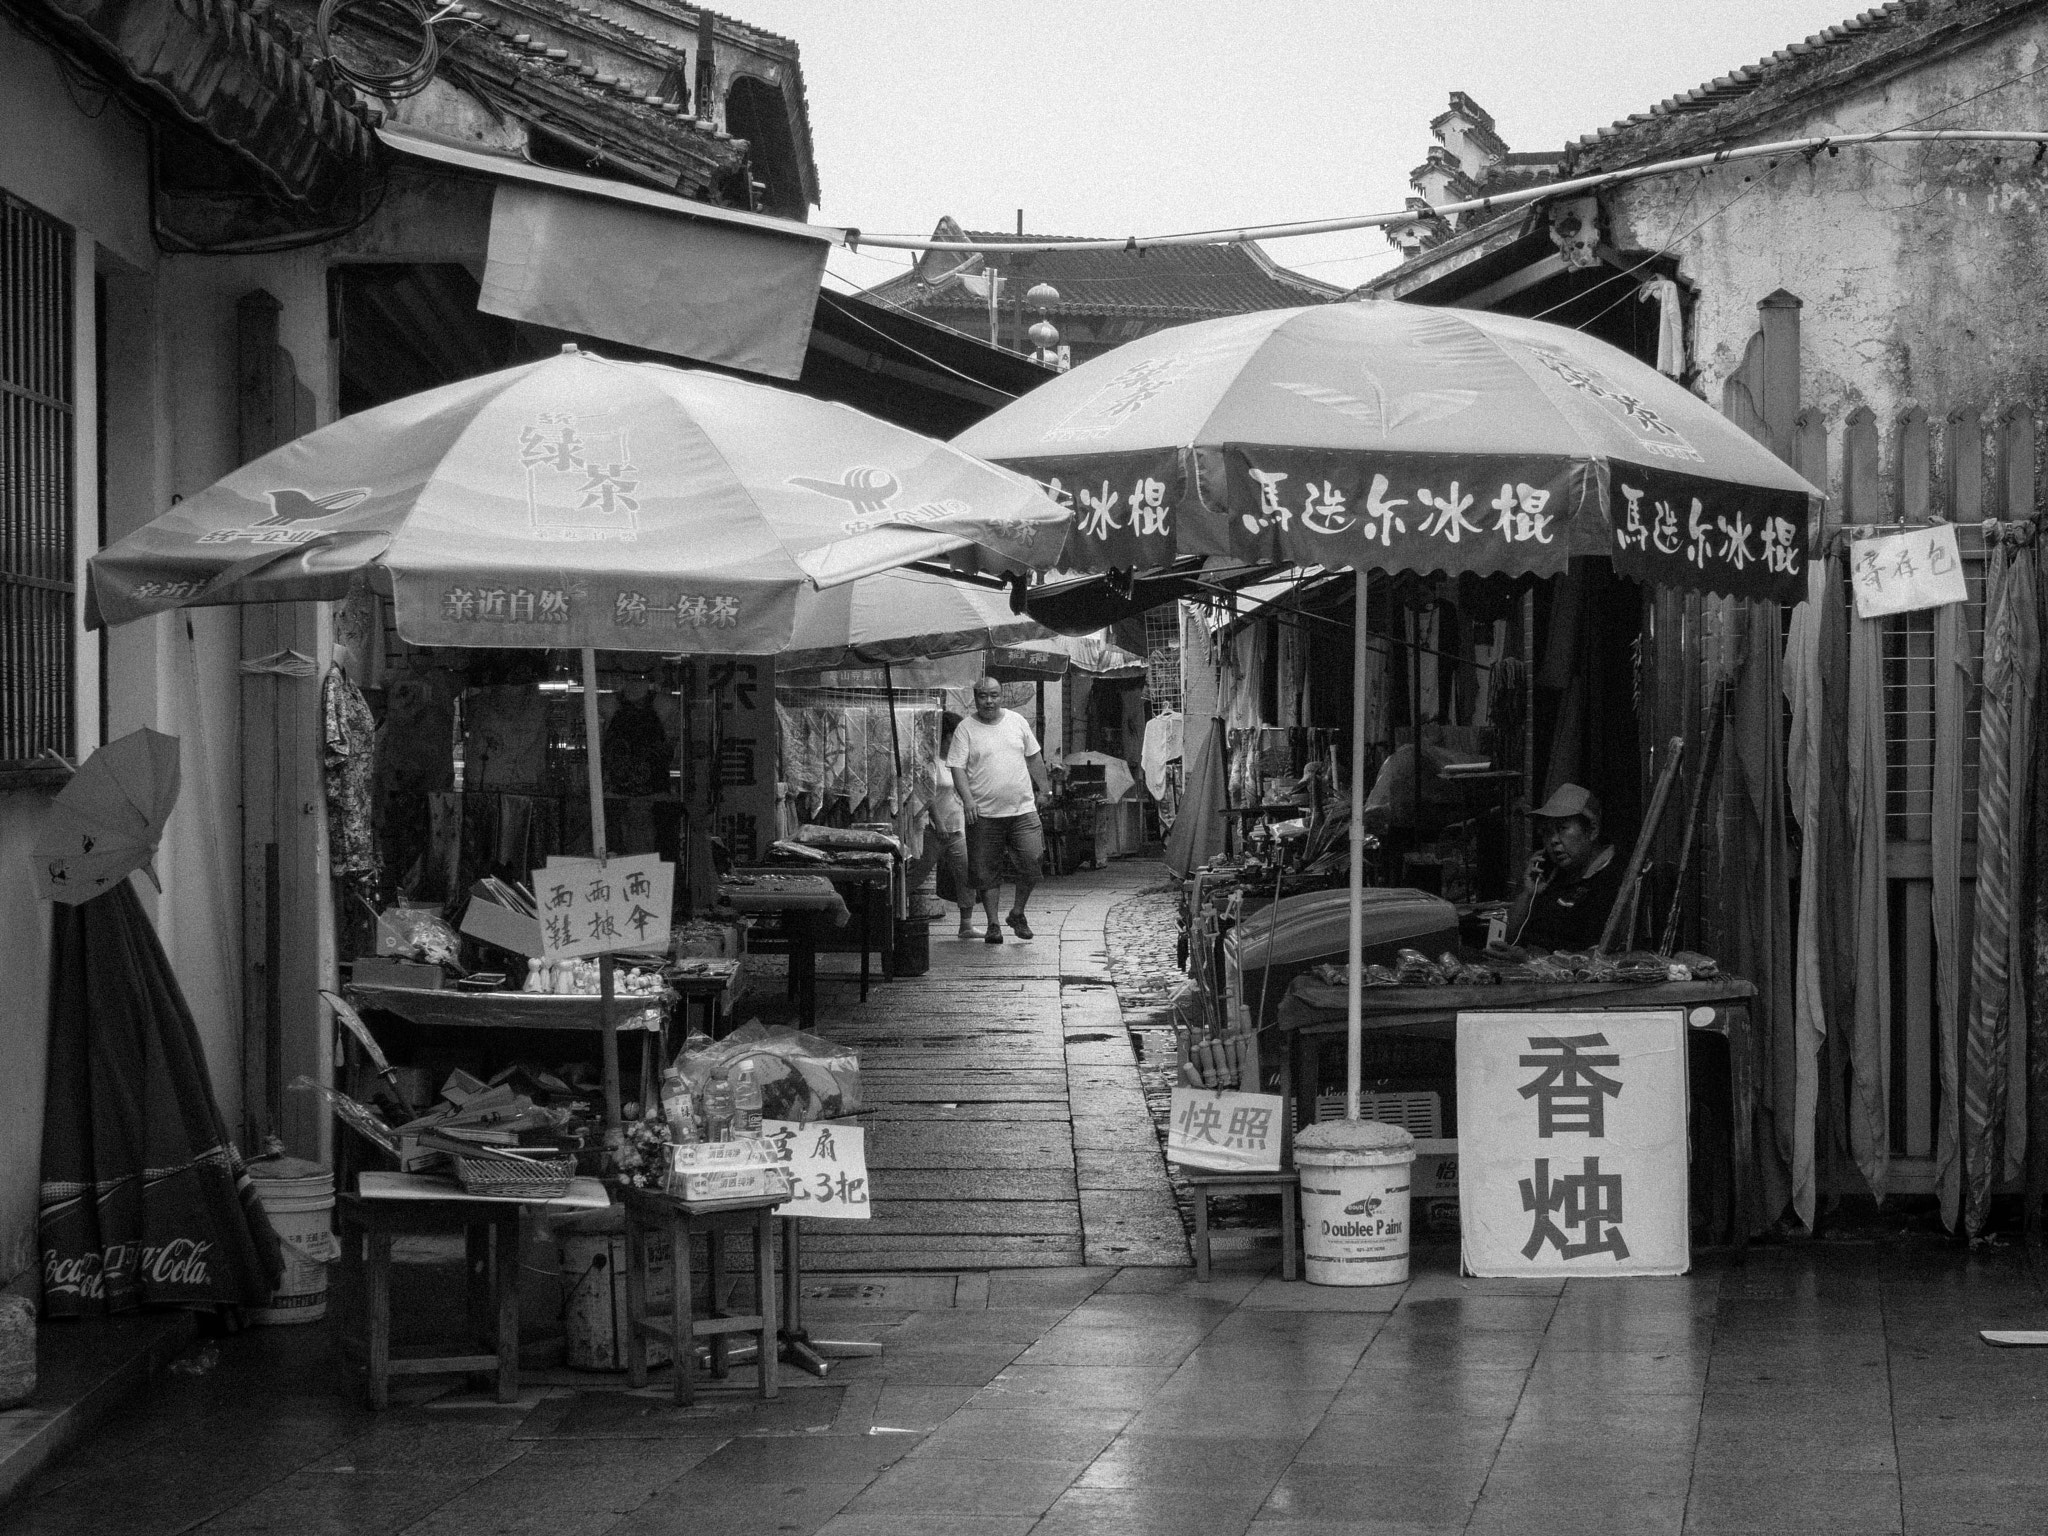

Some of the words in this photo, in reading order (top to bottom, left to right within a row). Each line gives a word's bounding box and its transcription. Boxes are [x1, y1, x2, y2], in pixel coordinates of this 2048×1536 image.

[519, 425, 640, 513] 绿茶
[130, 581, 207, 599] 亲近
[444, 588, 570, 622] 亲近自然
[615, 592, 740, 628] 统一绿茶
[1178, 1100, 1273, 1150] 快照
[1516, 1032, 1631, 1262] 香烛
